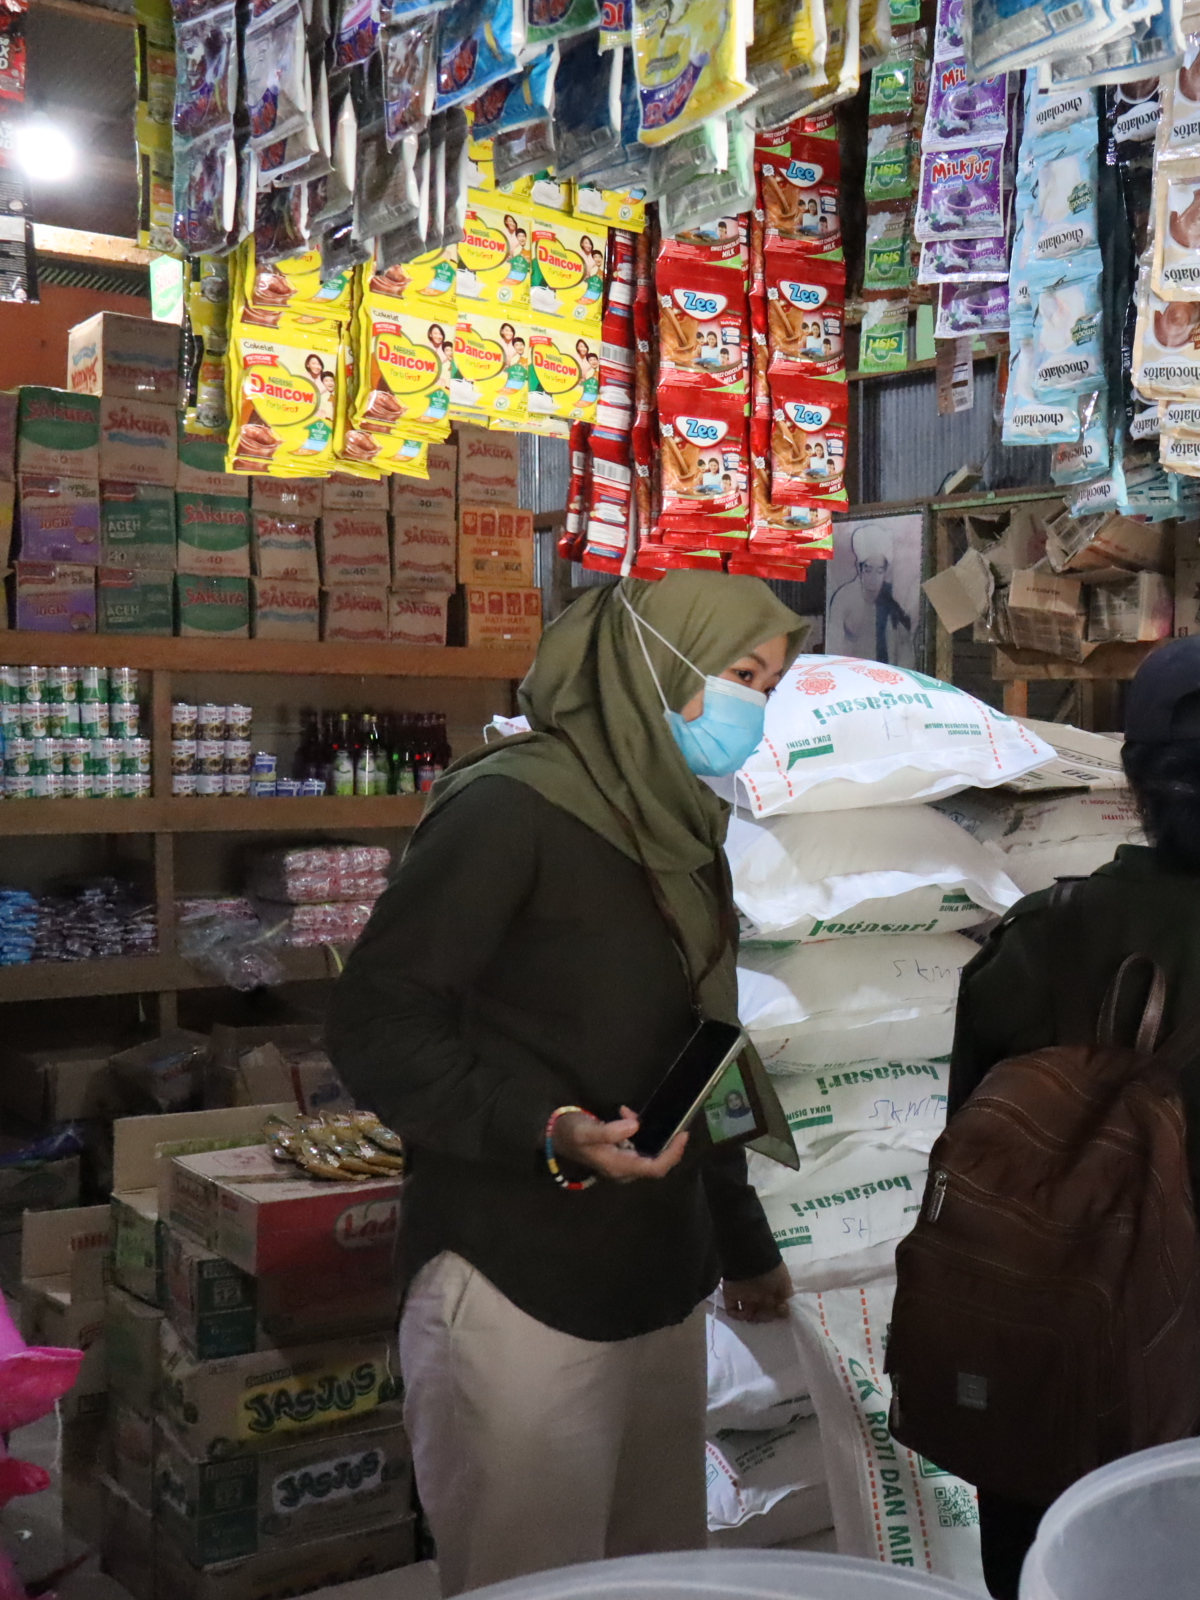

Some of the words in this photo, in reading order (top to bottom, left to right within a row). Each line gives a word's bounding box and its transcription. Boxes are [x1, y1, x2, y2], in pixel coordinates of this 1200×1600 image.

[772, 135, 785, 146] MILK
[721, 248, 735, 258] MILK
[822, 241, 836, 252] MILK
[789, 283, 820, 304] Zee
[683, 291, 717, 314] Zee
[982, 303, 1009, 316] ANGGU
[794, 405, 823, 426] Zee
[686, 419, 718, 440] Zee
[108, 520, 141, 532] ACEH
[107, 605, 139, 617] ACEH
[812, 689, 934, 725] bogasari
[786, 737, 811, 750] DISINI
[812, 733, 833, 746] BUKA
[939, 904, 959, 914] BUKA
[814, 1061, 941, 1096] bogasari
[785, 1109, 808, 1121] DISIN
[809, 1104, 832, 1114] BUKA
[789, 1174, 914, 1218] bogasari
[343, 1204, 397, 1241] Lad
[772, 1228, 787, 1239] DIS
[788, 1225, 810, 1236] BUKA
[866, 1410, 898, 1475] ROTI
[880, 1469, 908, 1516] DAN
[889, 1523, 915, 1568] MIE
